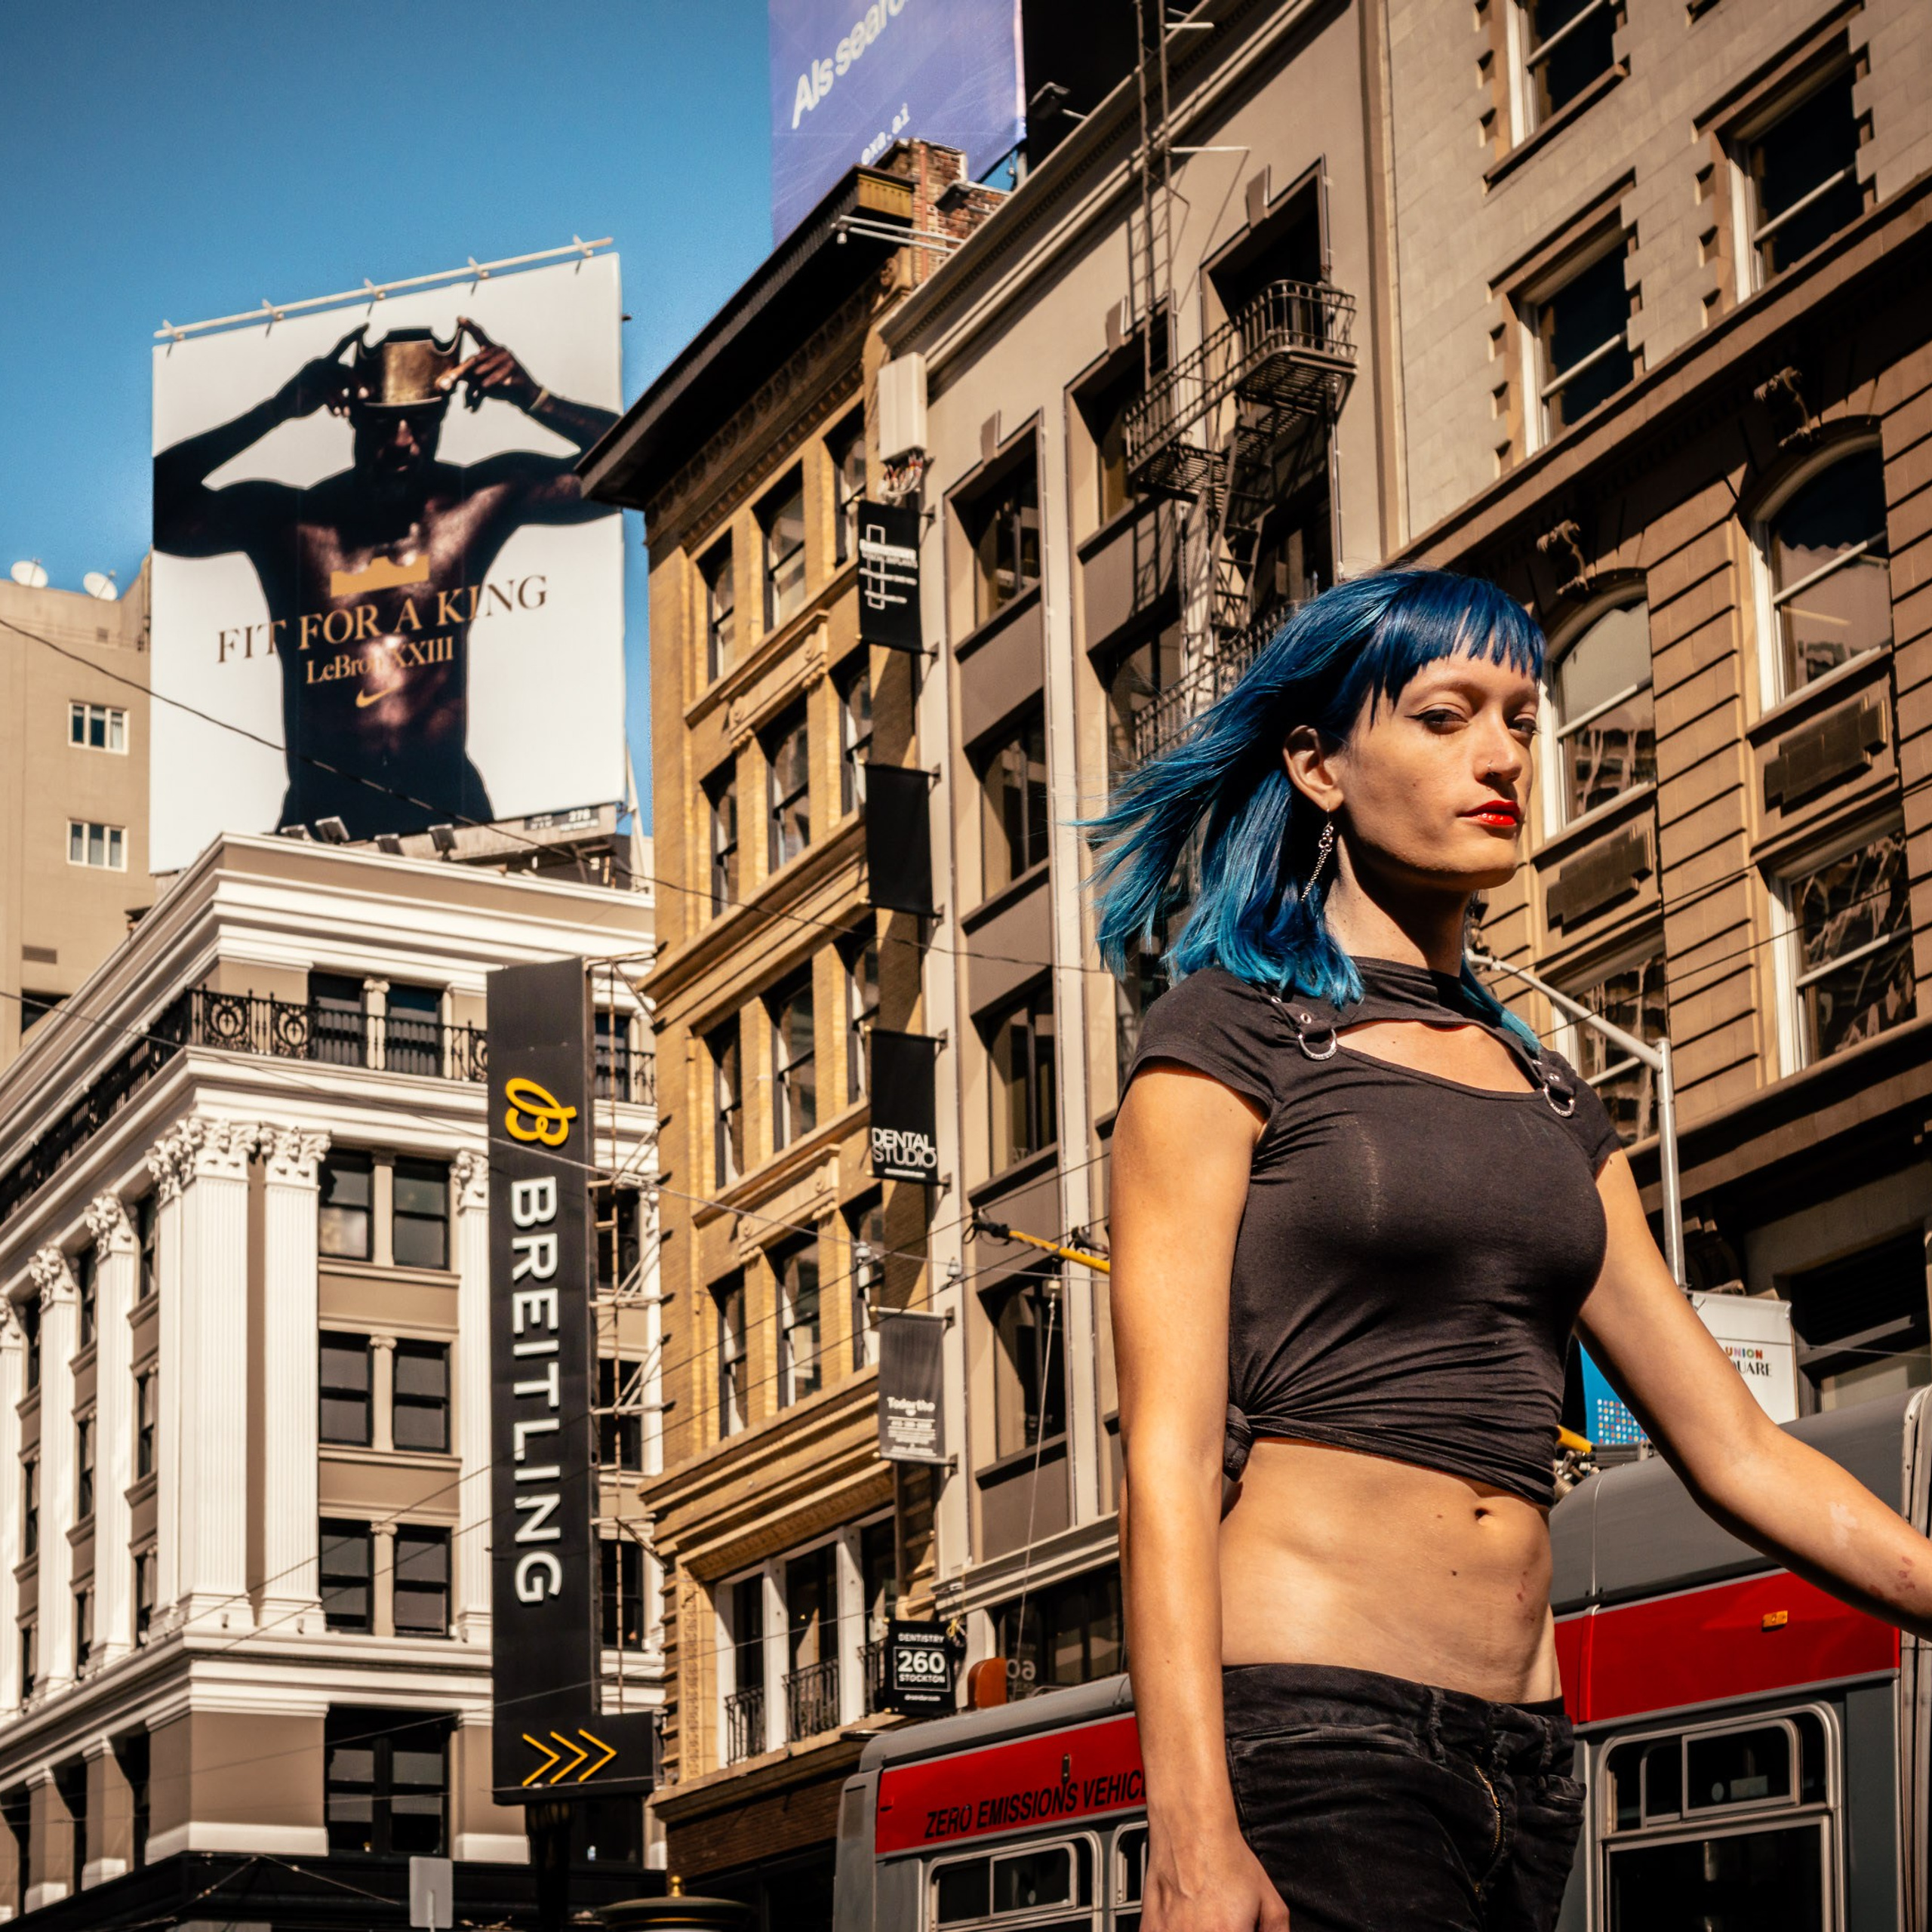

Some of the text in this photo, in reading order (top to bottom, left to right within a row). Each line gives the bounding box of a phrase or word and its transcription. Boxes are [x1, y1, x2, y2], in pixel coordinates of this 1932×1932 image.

[217, 574, 547, 663] FIT FOR A KING
[306, 636, 453, 684] LeBron XXIII
[872, 1128, 935, 1152] DENTAL
[872, 1144, 937, 1168] STUDIO
[1725, 1346, 1763, 1359] UNION
[1733, 1360, 1772, 1377] UARE
[511, 1177, 561, 1602] BREITLING
[898, 1633, 944, 1643] DENTISTRY
[898, 1651, 945, 1673] 260
[899, 1674, 946, 1683] STOCKTON
[924, 1804, 971, 1838] ZERO
[977, 1782, 1078, 1829] EMISSIONS
